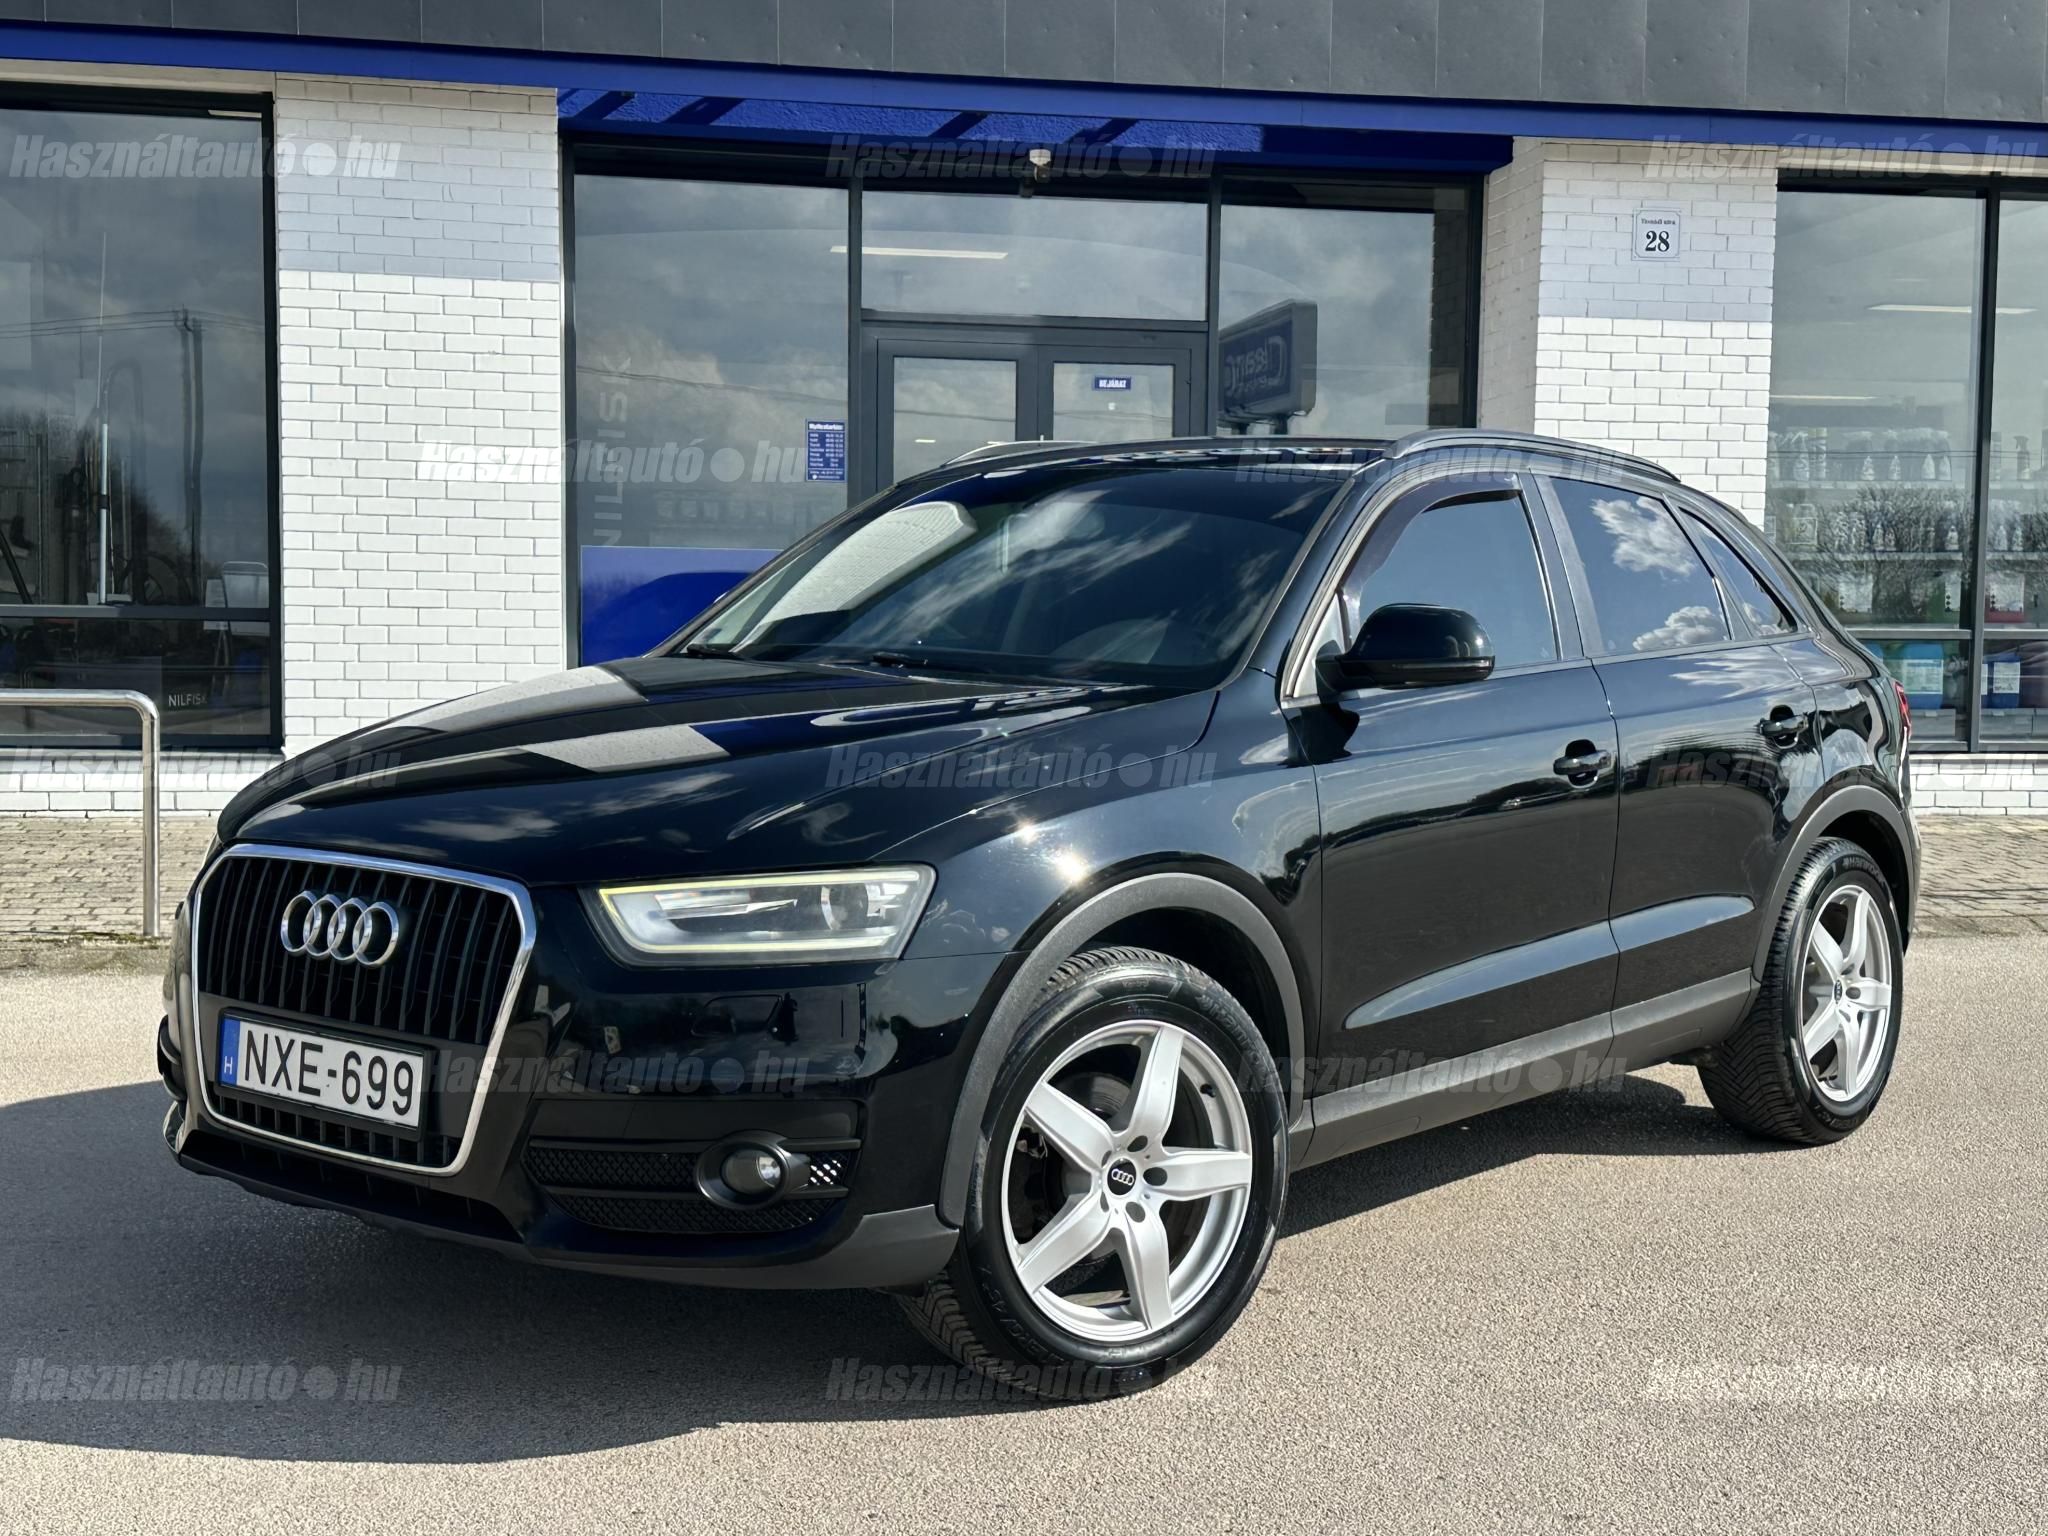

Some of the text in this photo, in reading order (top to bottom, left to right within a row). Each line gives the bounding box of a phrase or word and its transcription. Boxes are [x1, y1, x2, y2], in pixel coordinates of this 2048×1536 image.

[1645, 230, 1670, 252] 28
[223, 1055, 233, 1075] H
[244, 1030, 414, 1116] NXE-699
